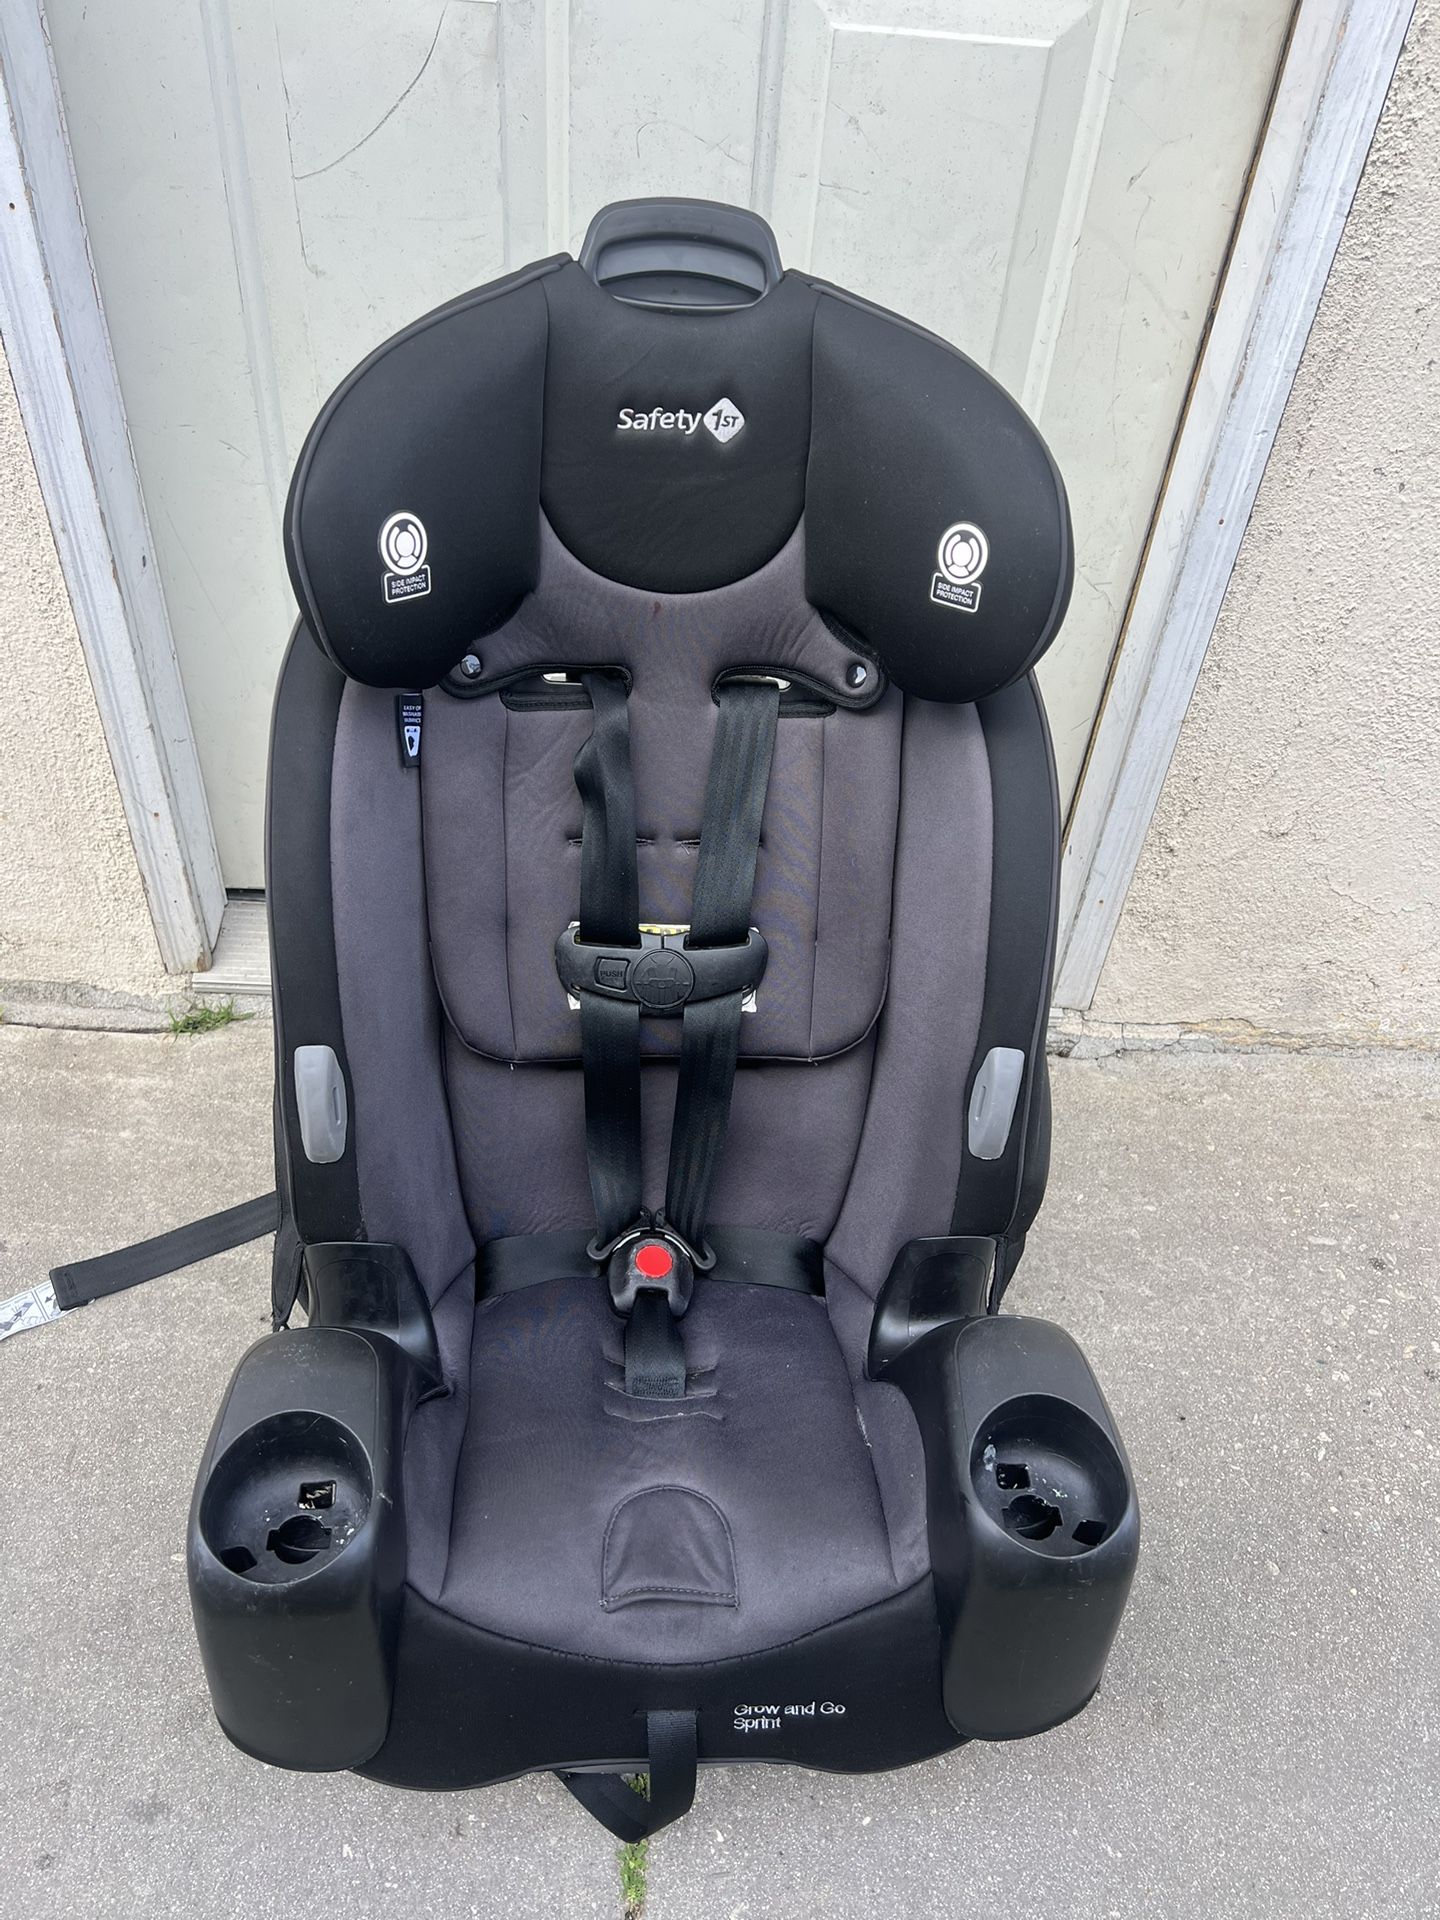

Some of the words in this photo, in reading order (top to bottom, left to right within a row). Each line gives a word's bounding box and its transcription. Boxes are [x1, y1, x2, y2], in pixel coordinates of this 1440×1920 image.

[617, 406, 702, 435] Safety
[391, 579, 405, 588] SIDE
[405, 574, 426, 585] IMPACT
[391, 581, 427, 595] PROTECTION
[936, 589, 973, 605] PROTECTION
[937, 582, 951, 591] SIDE
[951, 586, 974, 597] IMPACT
[600, 970, 623, 978] PUSH
[734, 1703, 780, 1716] Grow
[784, 1701, 815, 1716] and
[820, 1701, 846, 1714] Go
[733, 1715, 781, 1733] Sprint
